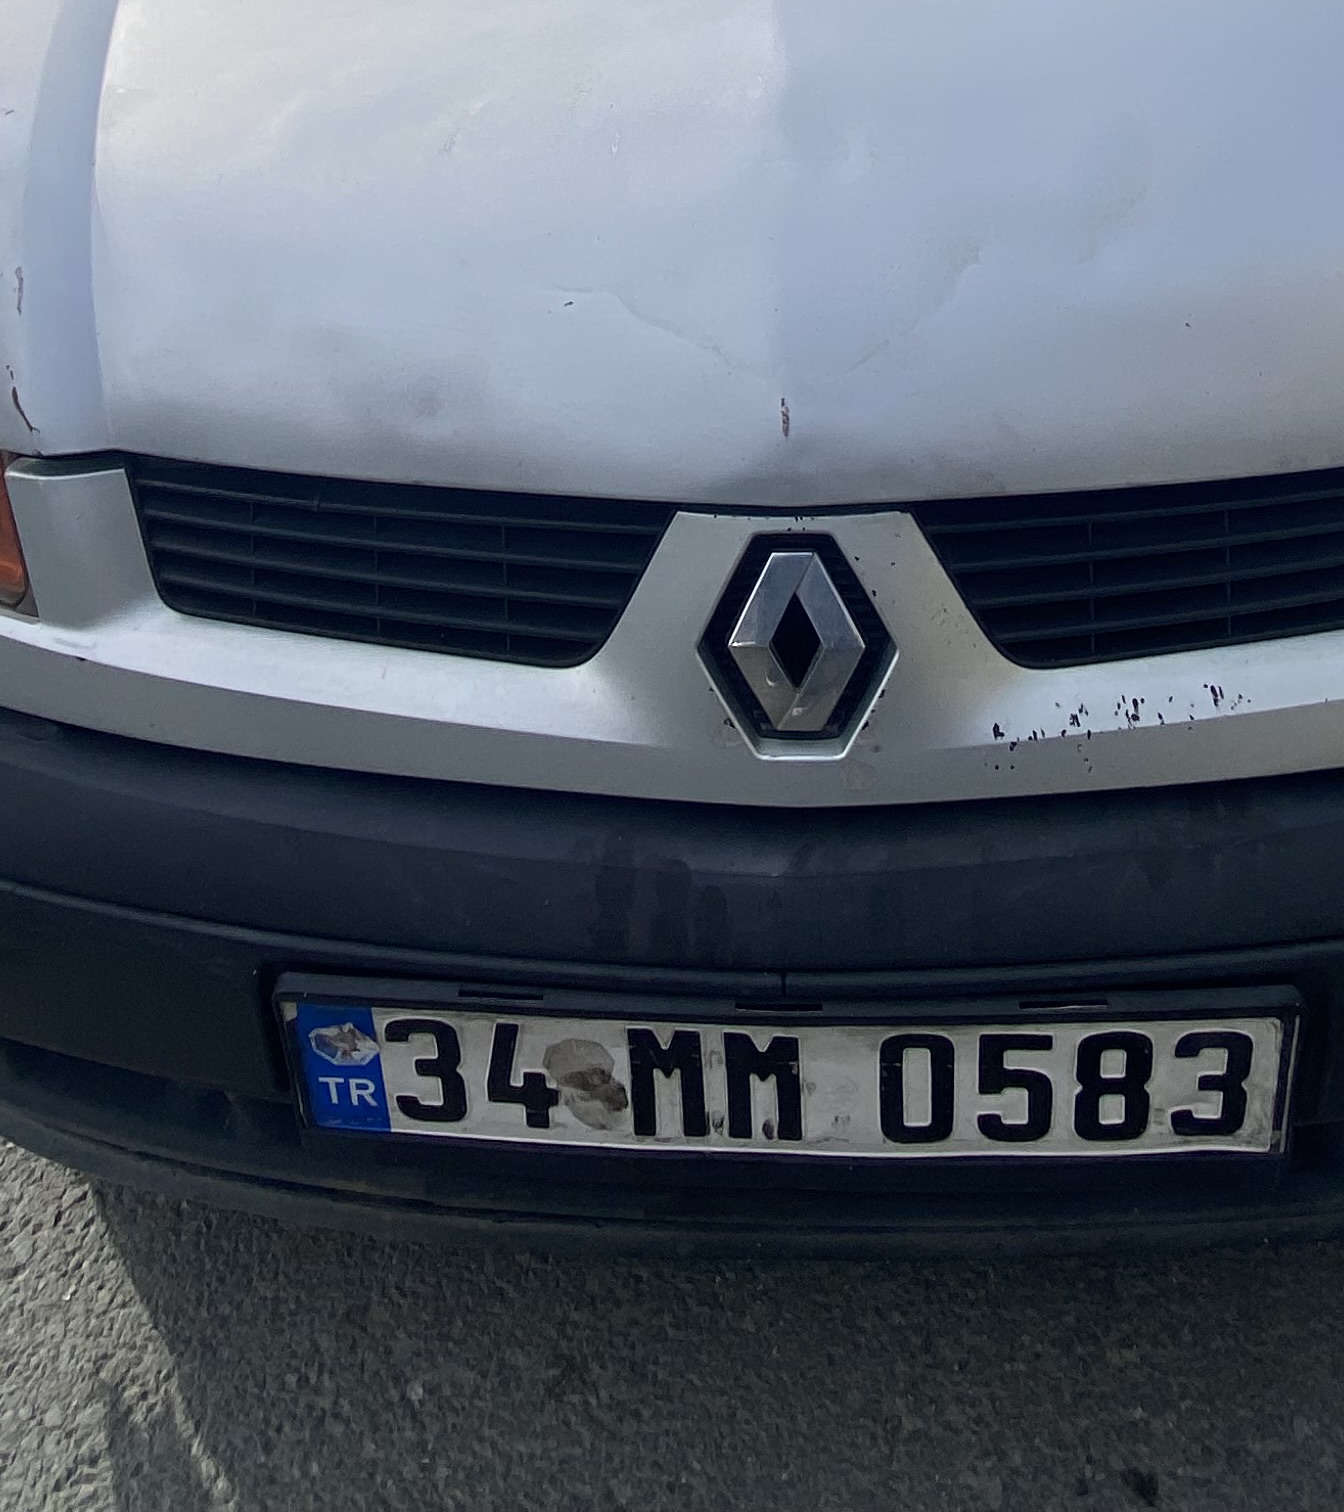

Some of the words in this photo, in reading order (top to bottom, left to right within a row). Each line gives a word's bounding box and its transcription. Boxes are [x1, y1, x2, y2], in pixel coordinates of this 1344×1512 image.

[316, 1074, 379, 1108] TR
[383, 1016, 563, 1130] 34
[627, 1026, 805, 1141] MM
[878, 1029, 1255, 1144] 0583
